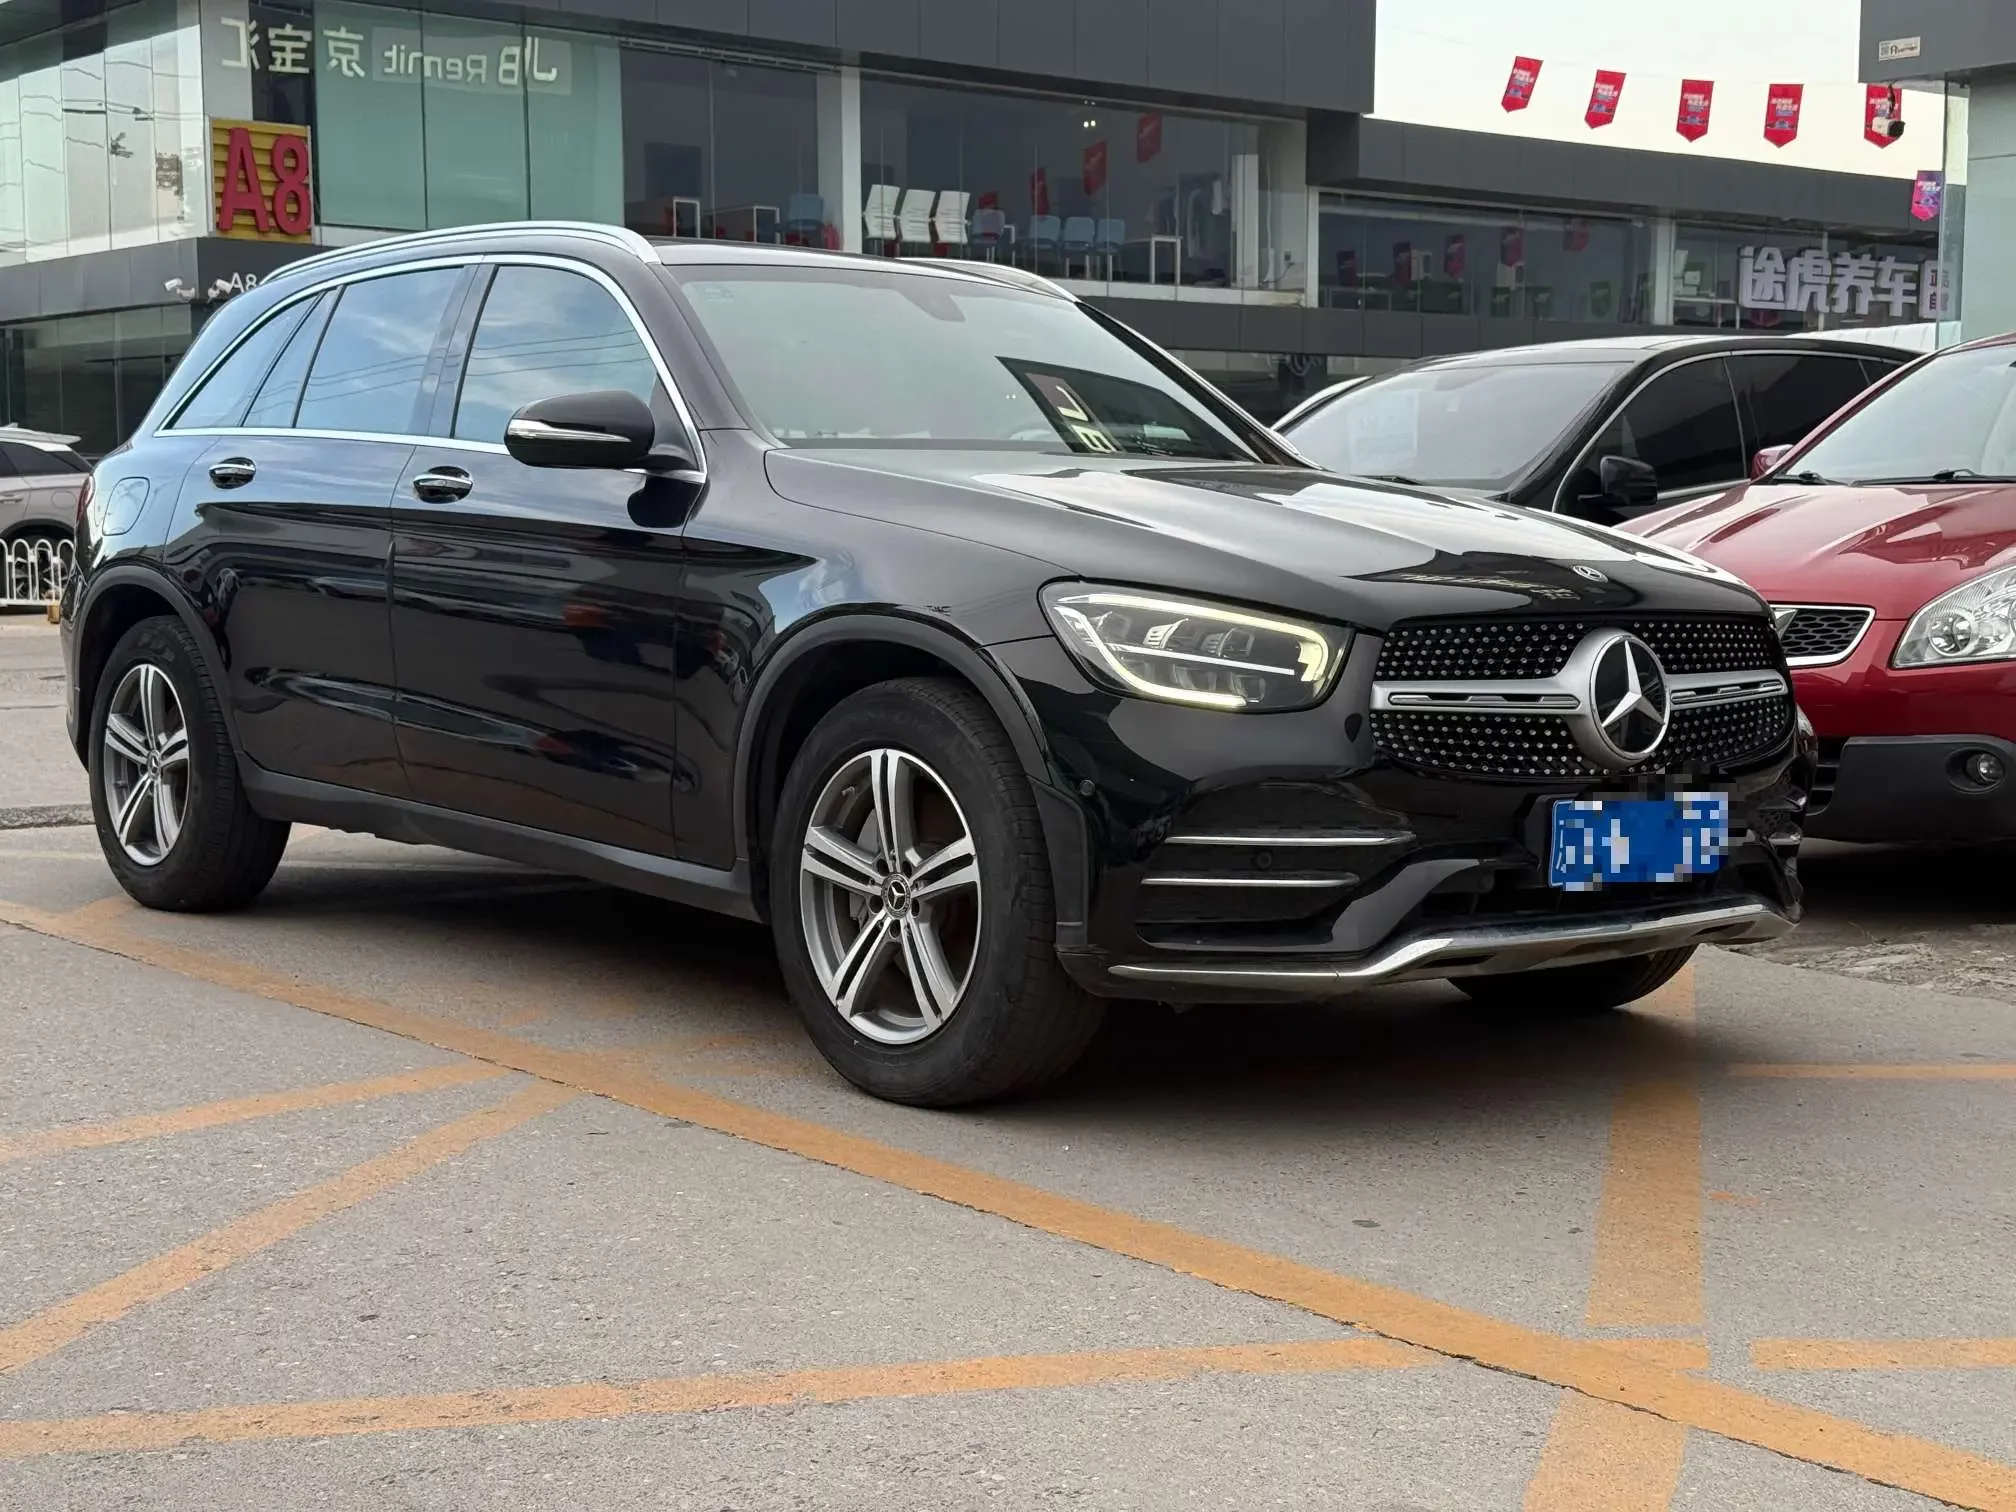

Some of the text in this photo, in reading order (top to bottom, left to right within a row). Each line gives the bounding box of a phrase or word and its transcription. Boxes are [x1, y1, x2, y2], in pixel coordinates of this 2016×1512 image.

[217, 127, 312, 235] A8
[1739, 246, 1919, 317] 途虎养车
